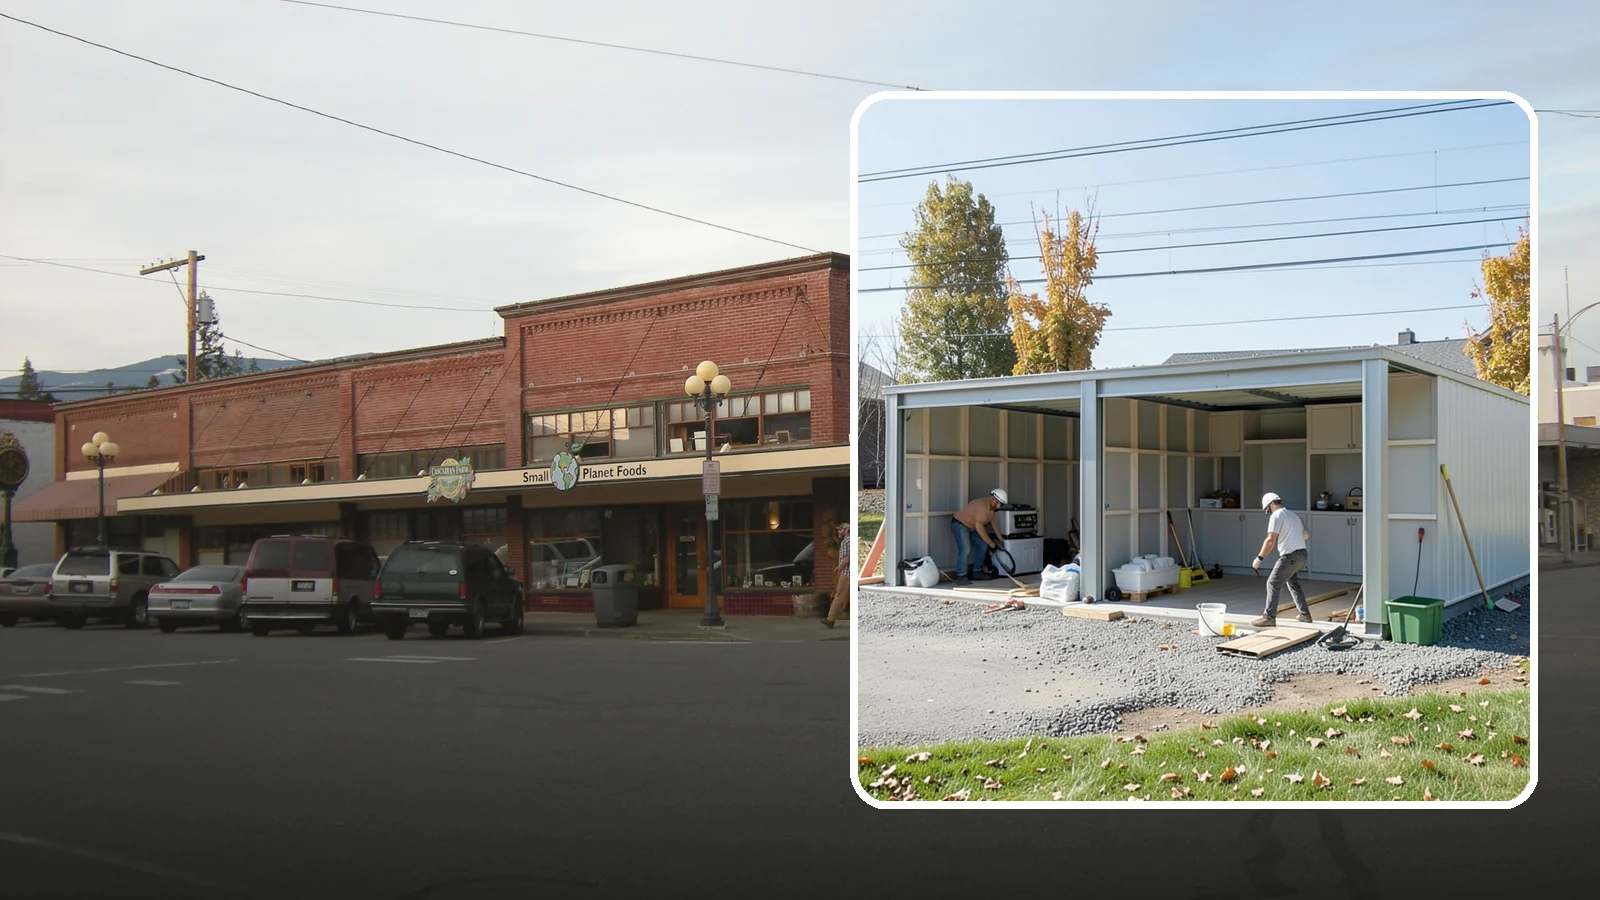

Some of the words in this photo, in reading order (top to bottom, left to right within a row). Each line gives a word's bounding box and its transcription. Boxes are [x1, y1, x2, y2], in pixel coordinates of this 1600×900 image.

[523, 471, 549, 483] Small
[583, 467, 614, 479] Planet
[617, 464, 647, 477] Foods
